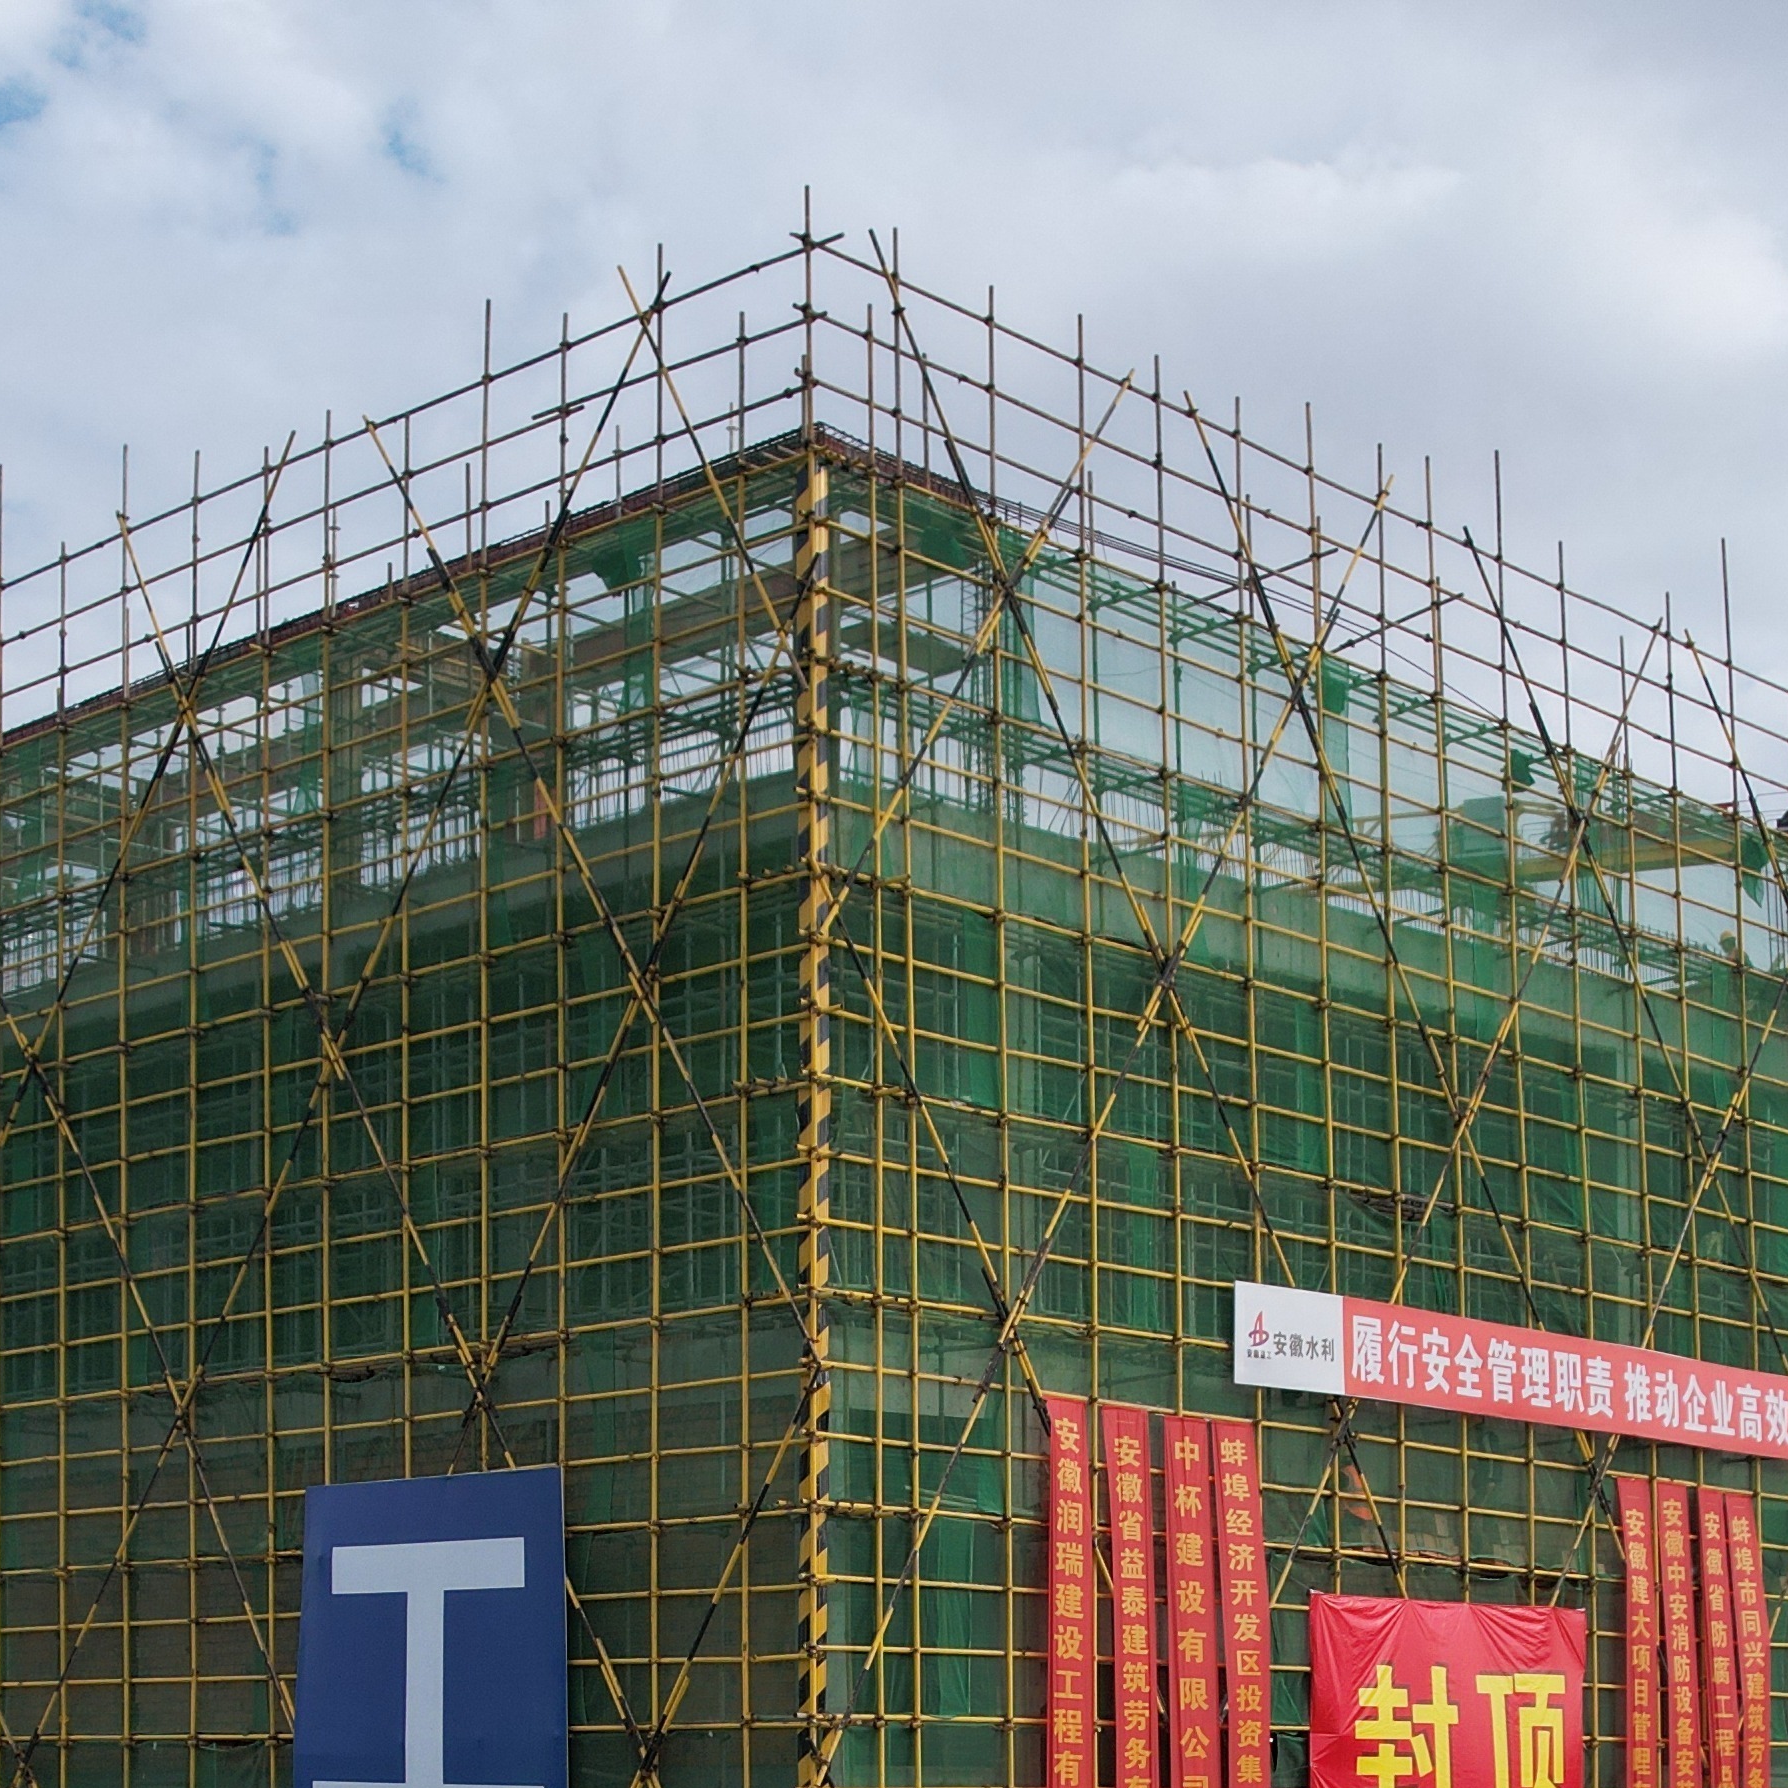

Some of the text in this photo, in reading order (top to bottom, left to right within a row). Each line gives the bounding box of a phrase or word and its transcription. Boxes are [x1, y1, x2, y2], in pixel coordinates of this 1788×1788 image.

[1273, 1331, 1335, 1362] 安徽水利
[1350, 1313, 1615, 1420] 履行安全管理职责
